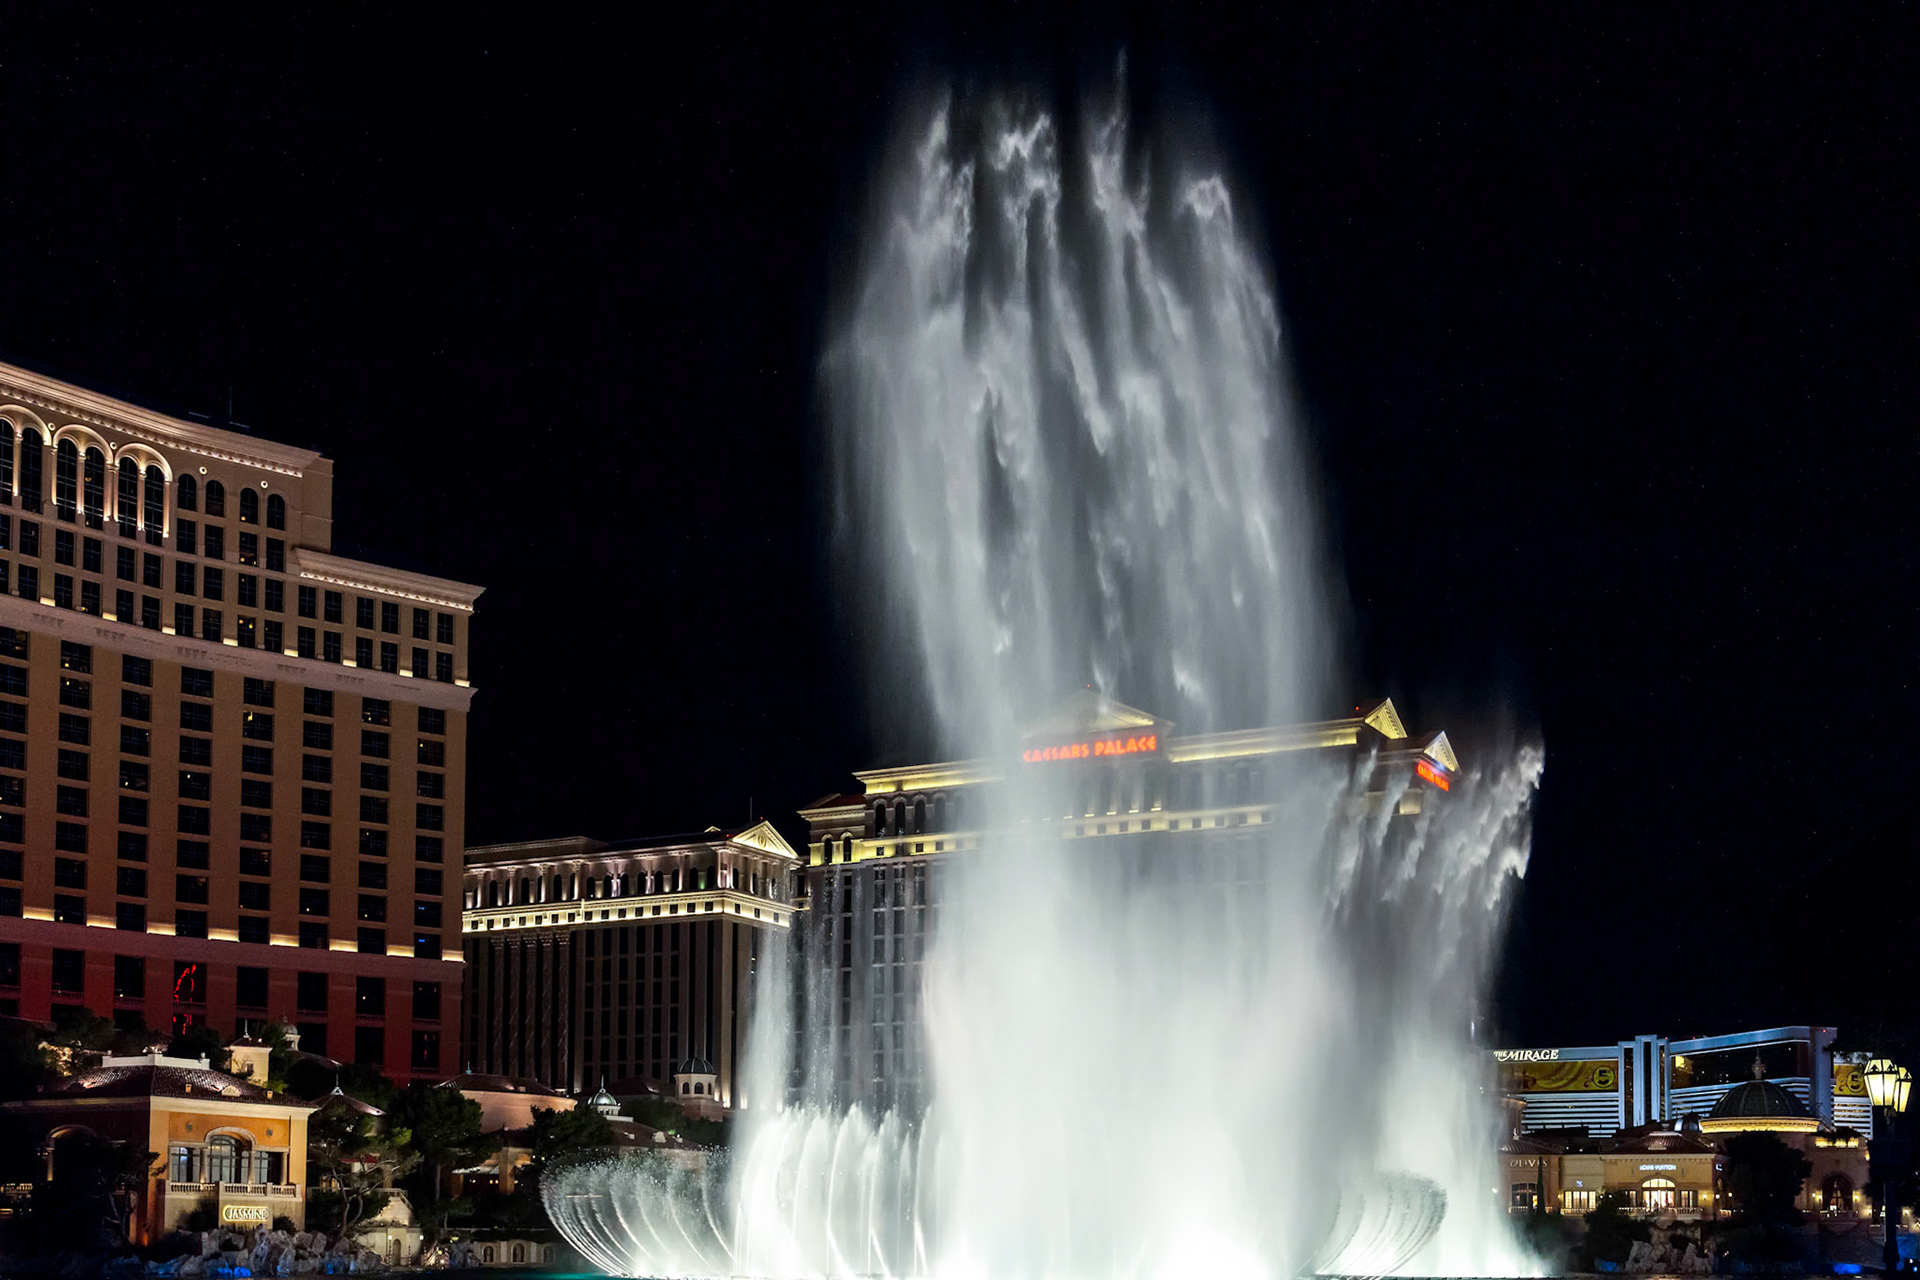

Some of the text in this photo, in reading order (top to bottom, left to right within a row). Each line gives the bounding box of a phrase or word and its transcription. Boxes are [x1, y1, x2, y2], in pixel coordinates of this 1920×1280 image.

[1023, 735, 1156, 763] CAESARS PALACE
[1498, 1049, 1559, 1062] MIRAGE
[1598, 1069, 1610, 1085] 5
[1850, 1074, 1861, 1090] 5
[1510, 1159, 1548, 1168] OLIVS
[228, 1208, 266, 1220] JASMINE
